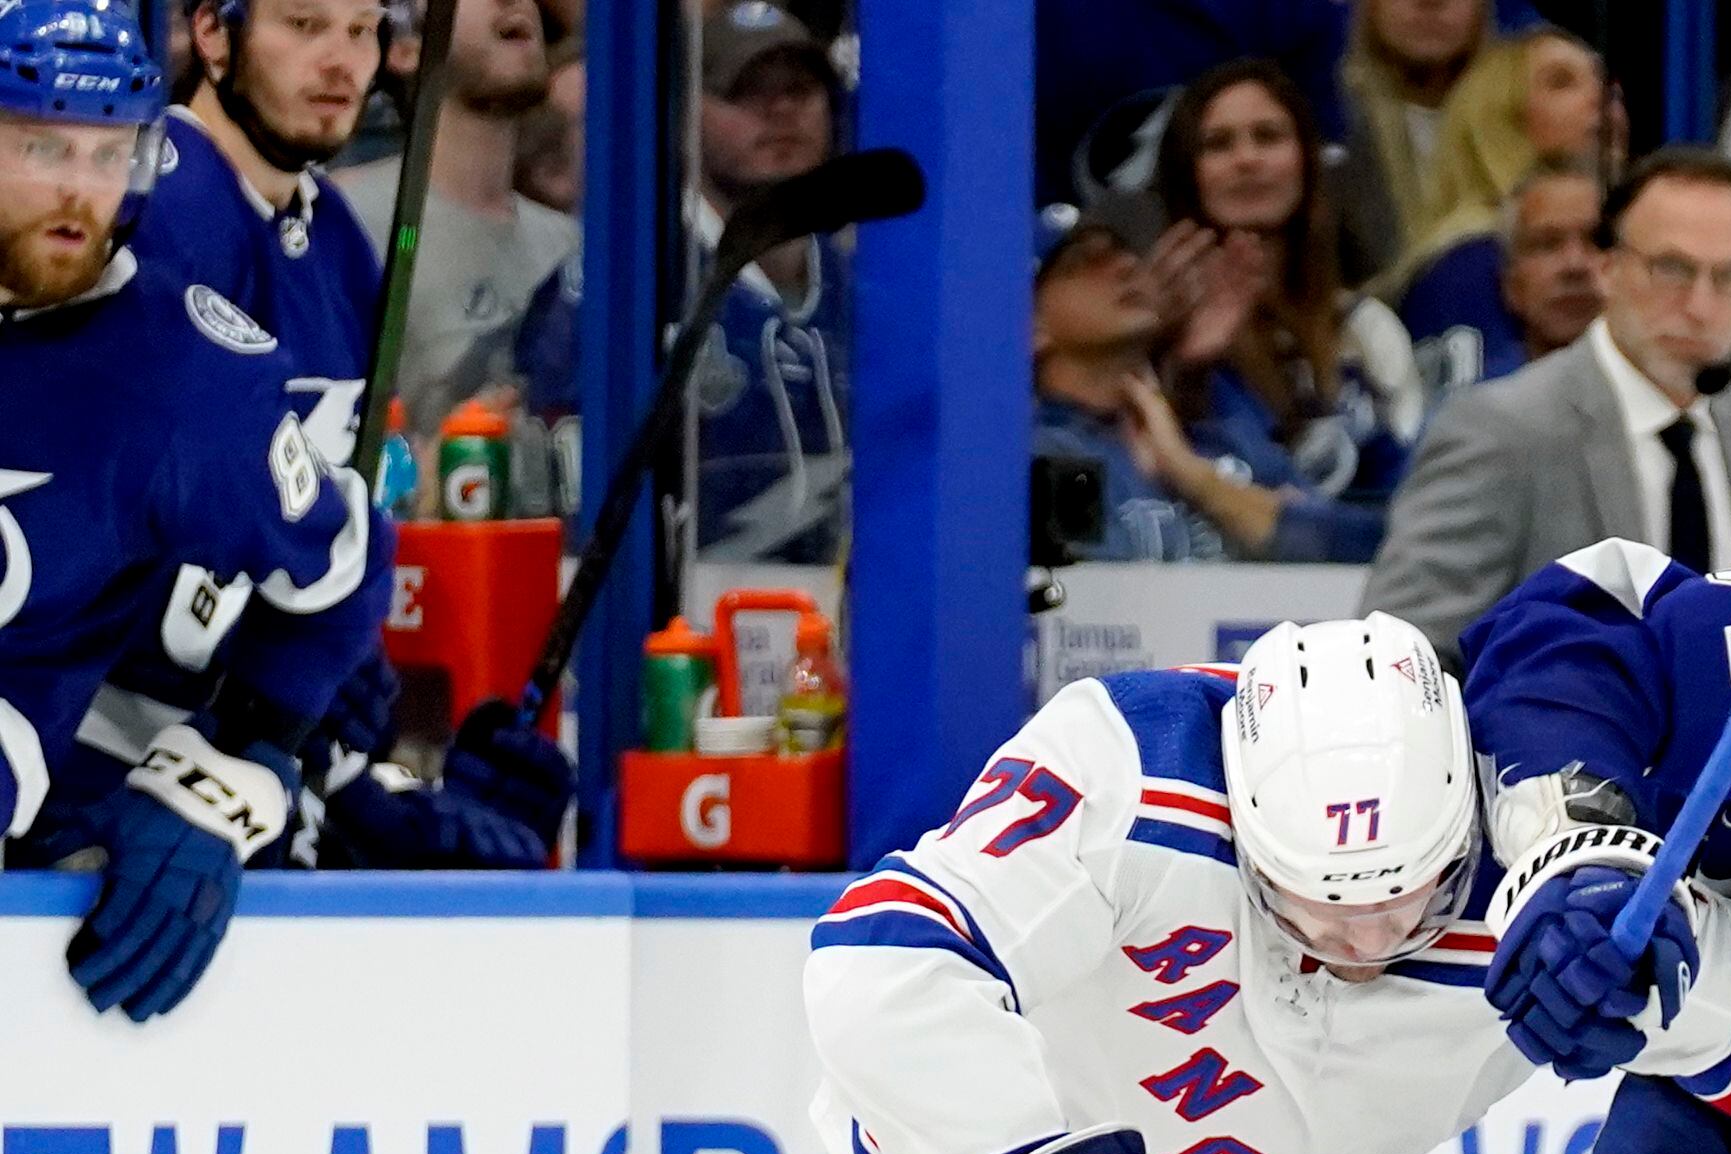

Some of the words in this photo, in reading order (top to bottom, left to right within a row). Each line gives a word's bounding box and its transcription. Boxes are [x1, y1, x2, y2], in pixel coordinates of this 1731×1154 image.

[54, 72, 121, 92] CCM
[445, 464, 490, 520] G
[680, 774, 732, 850] G
[936, 756, 1085, 859] 77
[1325, 798, 1381, 846] 77
[1321, 864, 1405, 882] CCM
